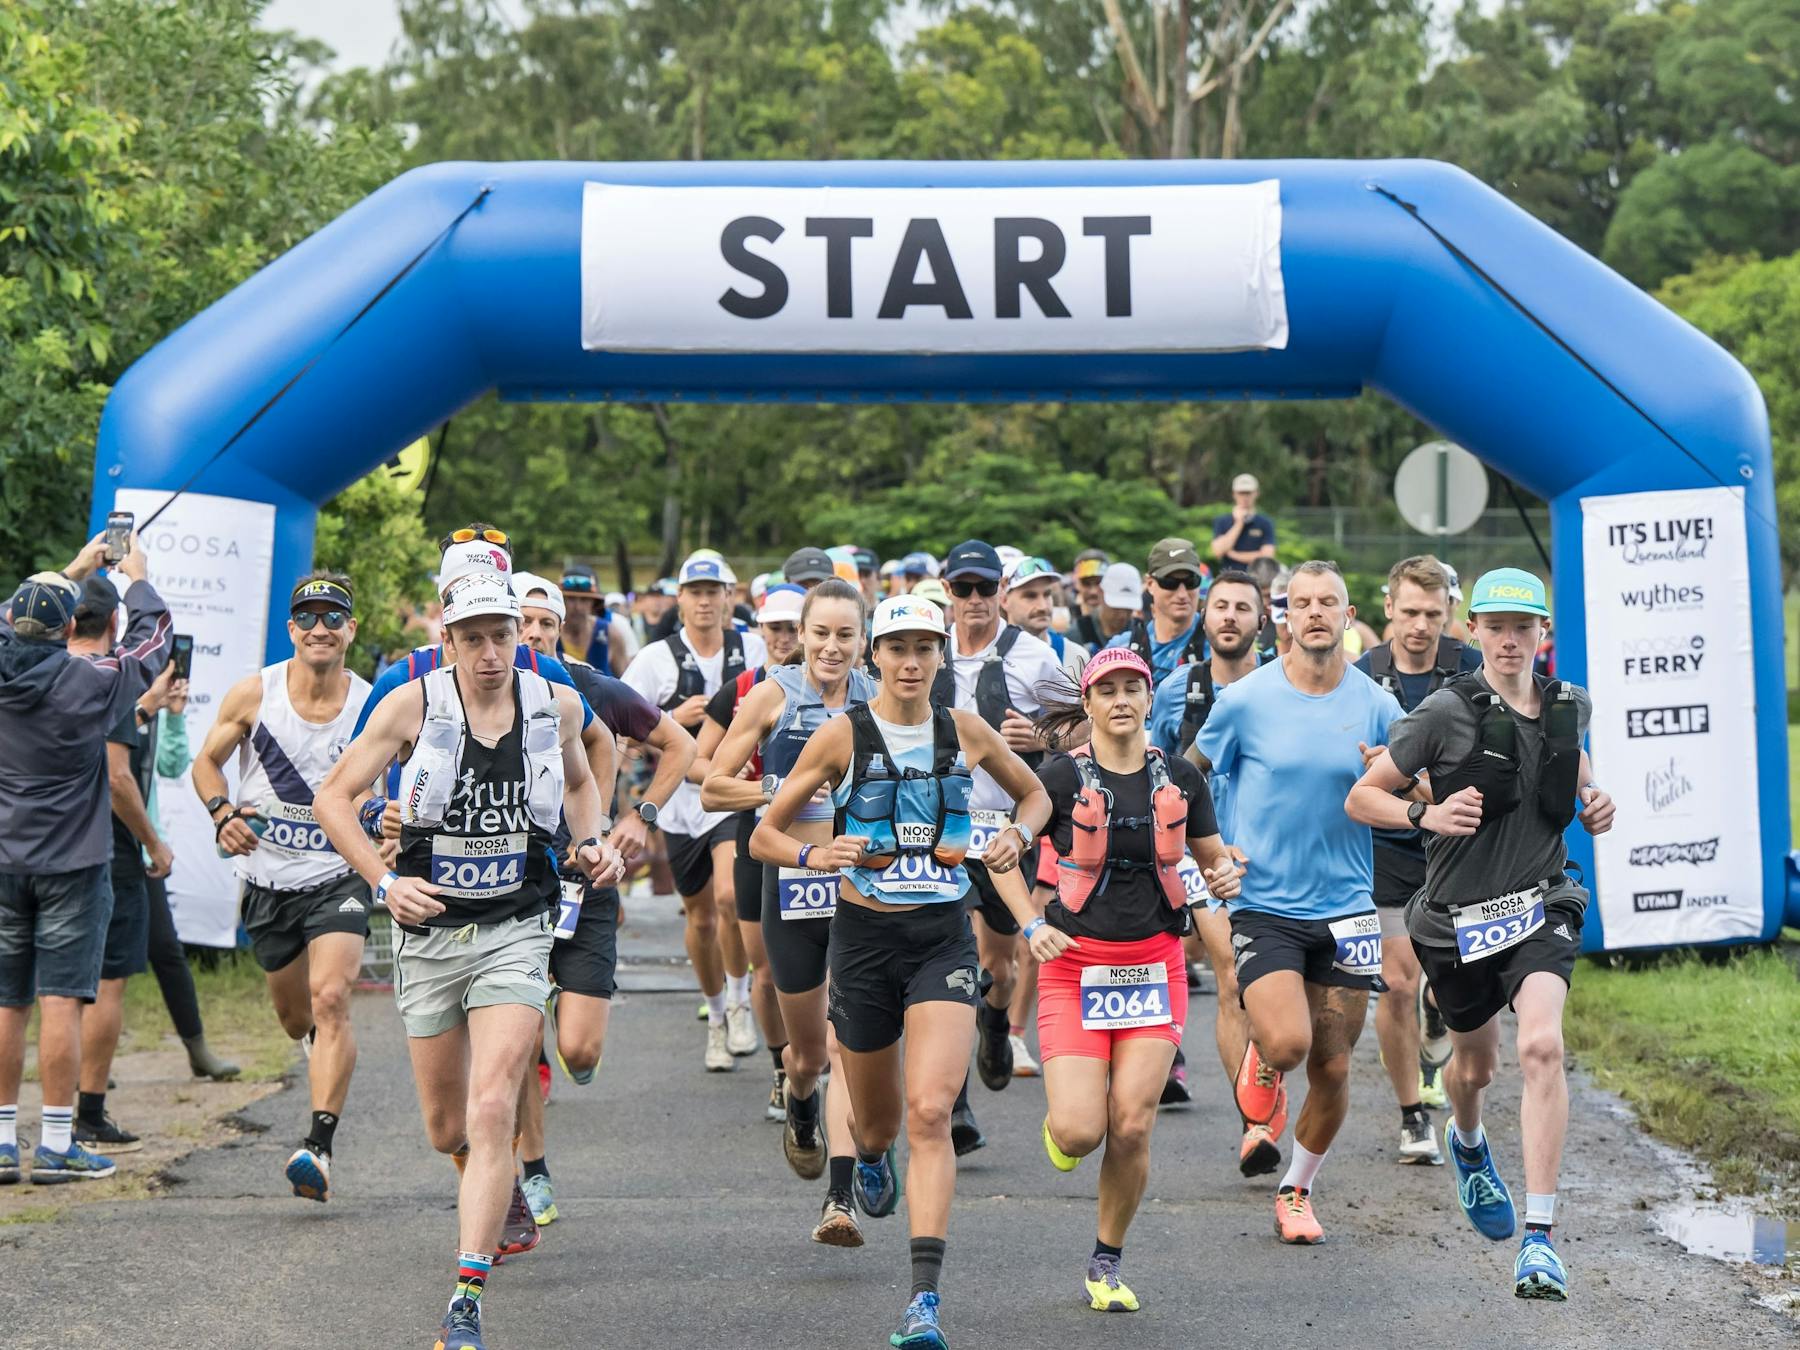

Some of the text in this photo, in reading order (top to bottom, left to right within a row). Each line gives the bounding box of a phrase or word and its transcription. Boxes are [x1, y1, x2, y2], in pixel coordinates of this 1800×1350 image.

[718, 215, 1151, 320] START
[1609, 518, 1713, 546] IT'S LIVE!
[1623, 535, 1708, 566] Queensland
[1488, 585, 1534, 601] HOKA
[1621, 583, 1704, 612] wythes
[890, 605, 934, 621] HOKA
[1624, 652, 1704, 676] FERRY
[1644, 706, 1707, 735] CLIF
[442, 807, 531, 833] crew
[261, 820, 327, 850] 2080
[464, 838, 509, 850] NOOSA
[437, 858, 518, 888] 2044
[788, 882, 842, 909] 201
[1481, 896, 1525, 915] NOOSA
[1637, 893, 1729, 909] UTMB INDEX
[1465, 908, 1535, 953] 2037
[1110, 967, 1150, 978] NOOSA
[1087, 989, 1163, 1018] 2064
